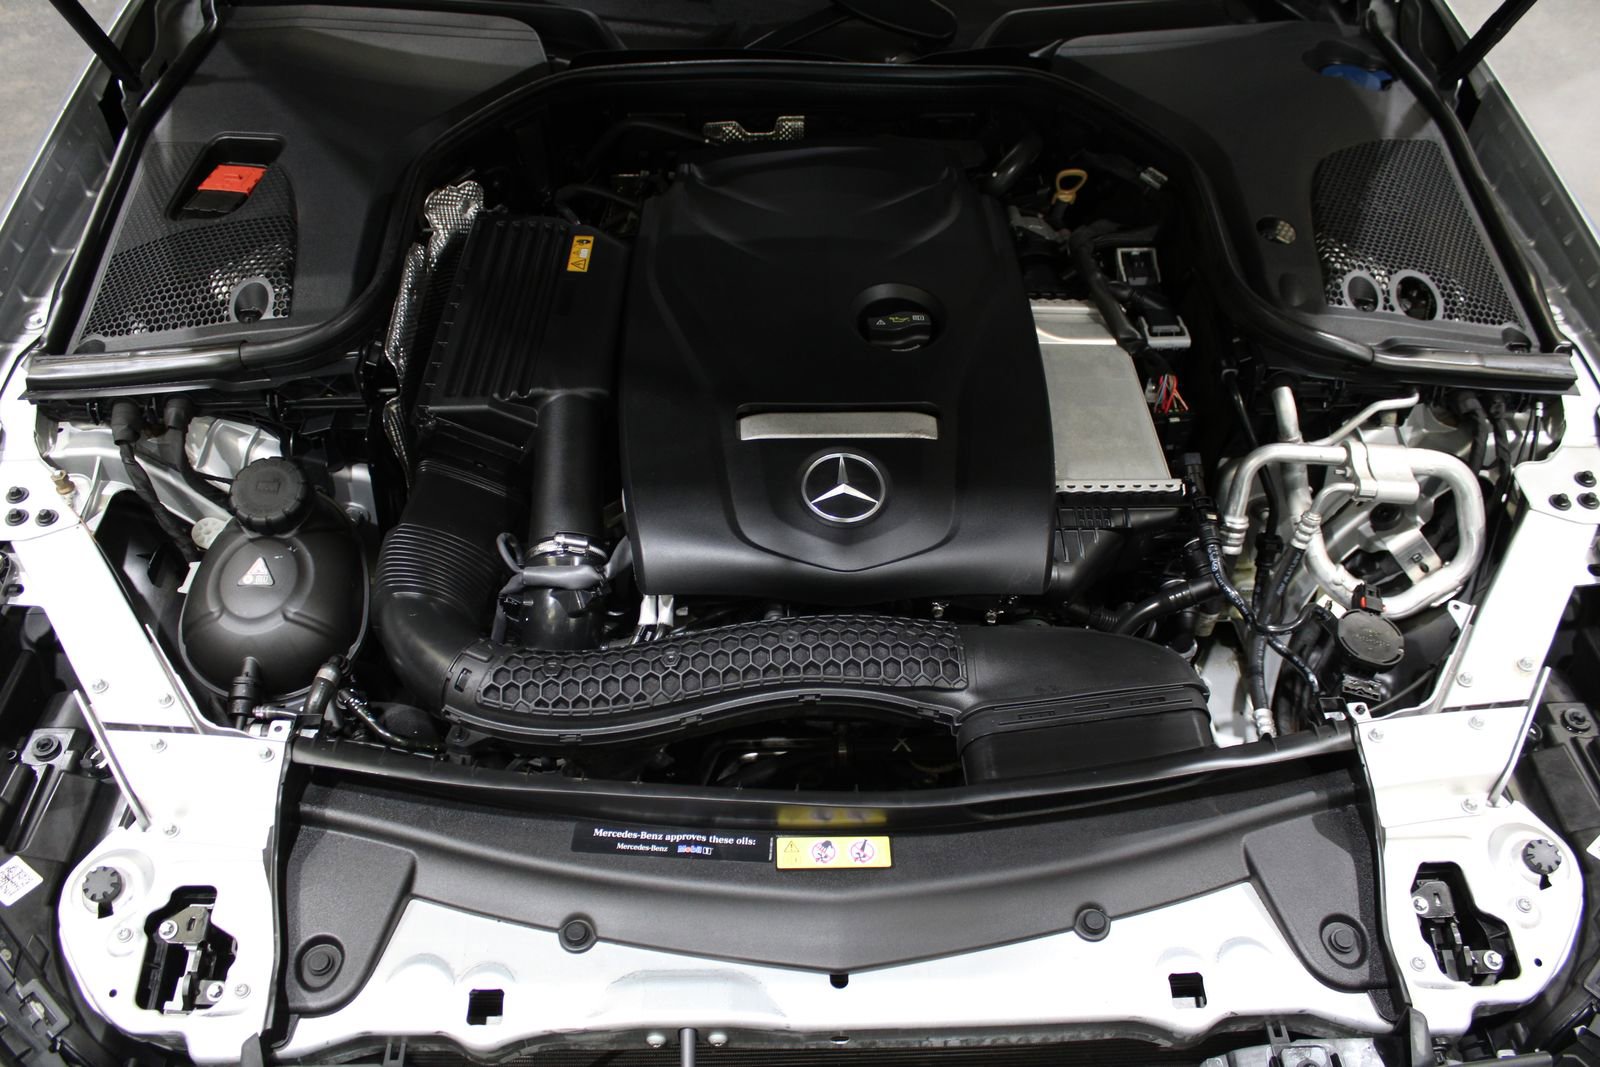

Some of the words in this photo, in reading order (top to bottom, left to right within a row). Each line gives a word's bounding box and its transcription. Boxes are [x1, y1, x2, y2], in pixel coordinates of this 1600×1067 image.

[593, 828, 663, 841] Mercedes-Benz
[665, 834, 707, 843] approves
[709, 835, 734, 845] these
[736, 837, 757, 846] oils:
[616, 842, 668, 853] Mercedes-Benz
